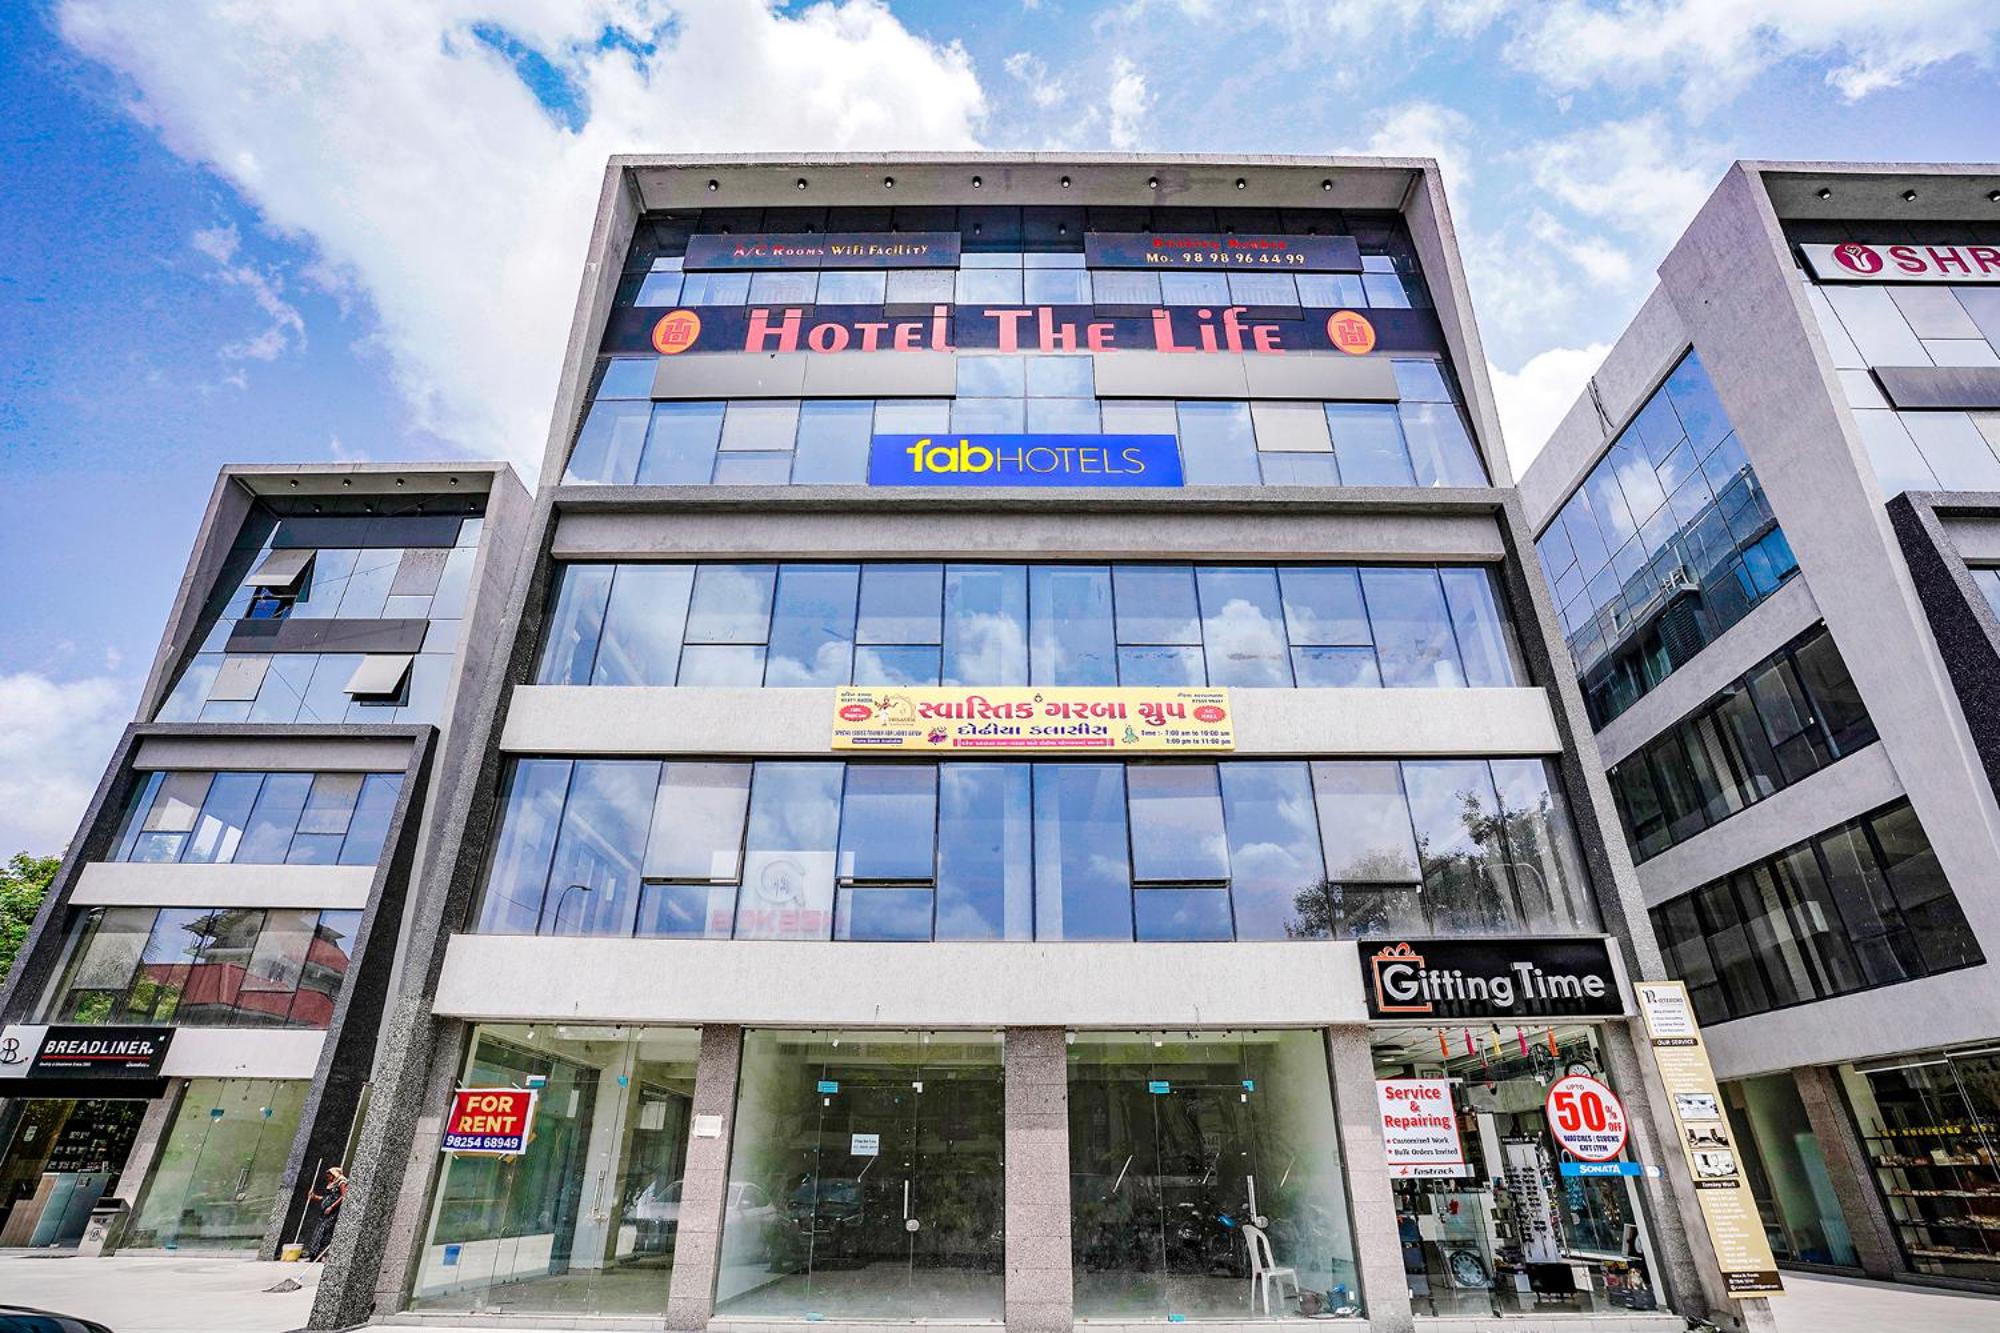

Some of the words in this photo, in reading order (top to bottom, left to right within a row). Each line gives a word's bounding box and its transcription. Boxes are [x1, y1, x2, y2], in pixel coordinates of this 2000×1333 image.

[1146, 252, 1174, 263] Mo.
[1182, 252, 1204, 263] 98
[1209, 253, 1230, 263] 98
[1235, 253, 1254, 263] 96
[1258, 254, 1281, 263] 44
[1285, 254, 1305, 264] 99
[744, 305, 957, 353] Hotel
[983, 306, 1119, 353] The
[1151, 306, 1287, 354] Life
[1385, 1086, 1441, 1100] Service
[466, 1095, 514, 1113] FOR
[1410, 1100, 1421, 1113] &
[1553, 1090, 1607, 1132] 50
[457, 1115, 517, 1133] RENT
[1384, 1114, 1452, 1131] Repairing
[446, 1135, 482, 1148] 98254
[483, 1137, 519, 1149] 68949
[1431, 1136, 1449, 1144] Work
[1411, 1148, 1434, 1156] Orders
[1413, 1167, 1455, 1176] fastrack
[1579, 1164, 1621, 1174] SONATA
